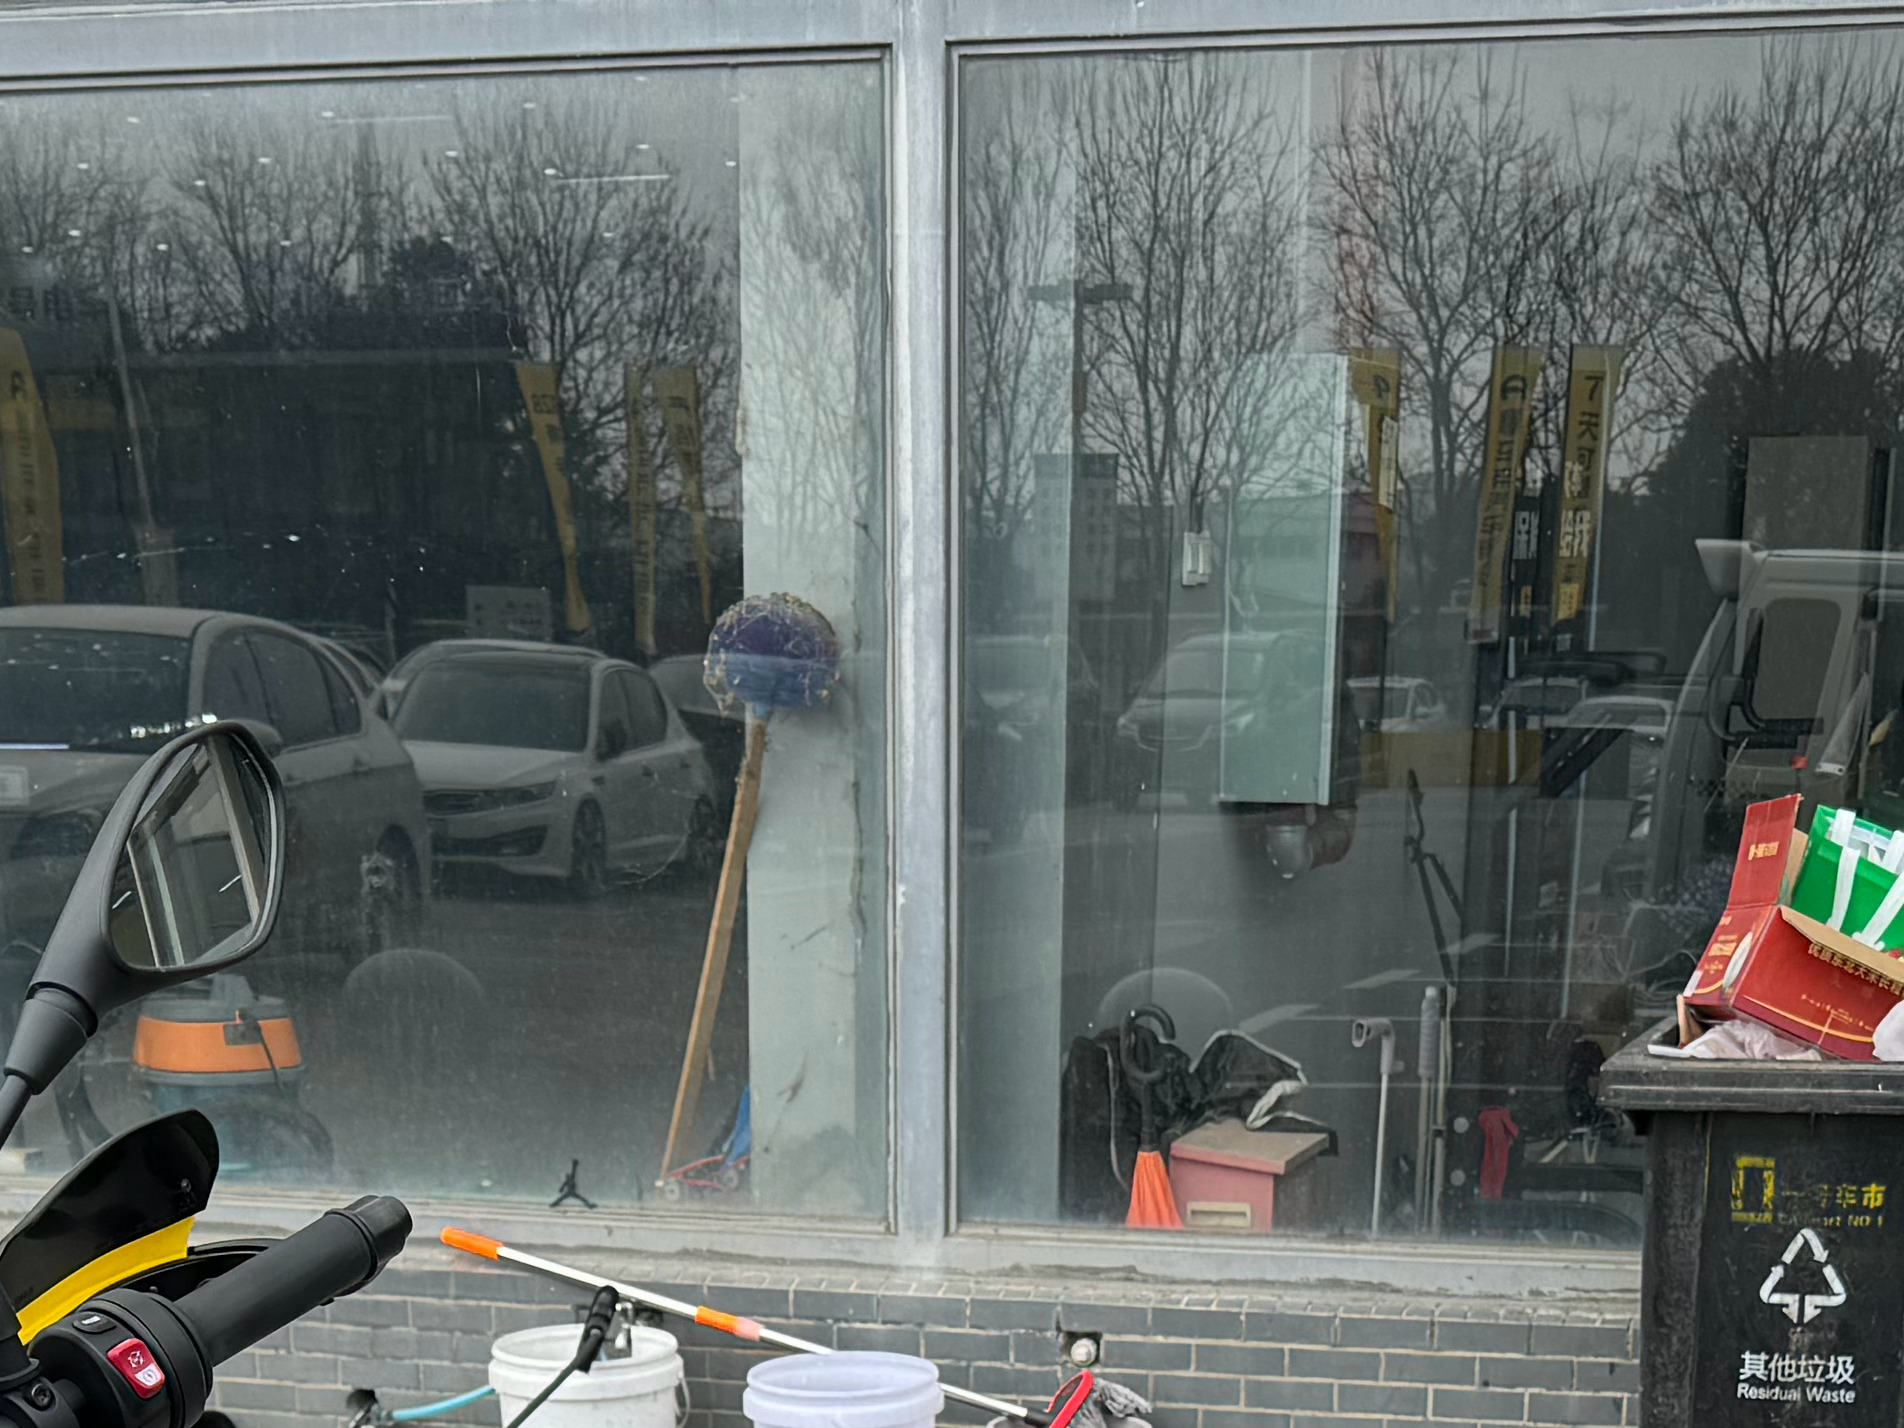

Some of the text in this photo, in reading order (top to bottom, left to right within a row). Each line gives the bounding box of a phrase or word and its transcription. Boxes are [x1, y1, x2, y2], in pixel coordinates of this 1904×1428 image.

[1739, 1350, 1856, 1385] 其他垃圾
[1736, 1382, 1856, 1404] Residual Waste
